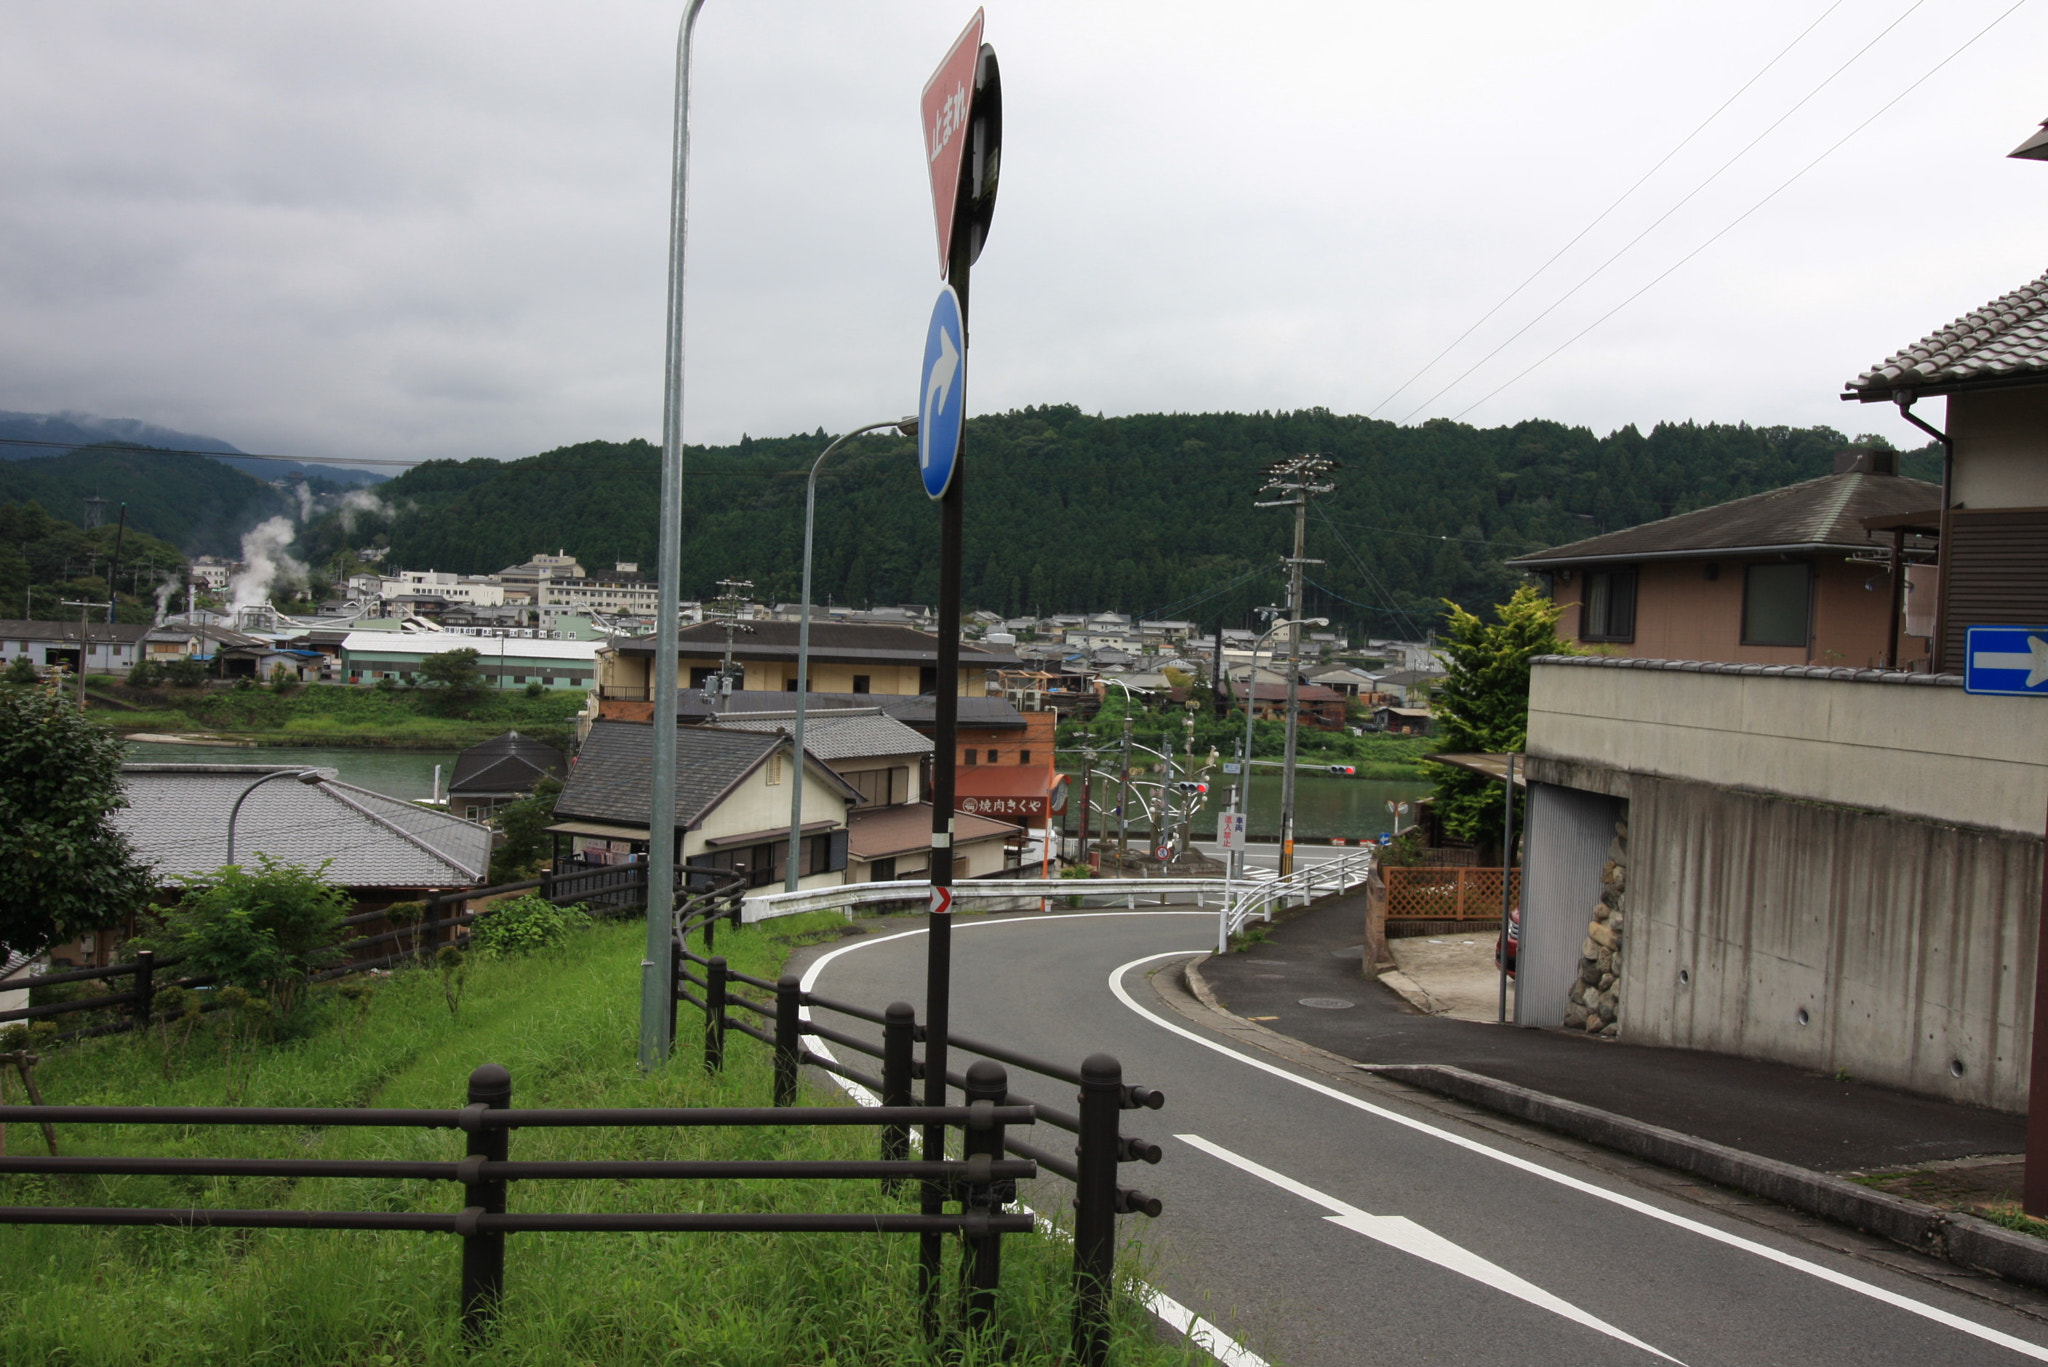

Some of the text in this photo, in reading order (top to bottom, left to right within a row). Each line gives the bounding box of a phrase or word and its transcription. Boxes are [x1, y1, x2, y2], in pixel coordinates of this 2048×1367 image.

[931, 80, 966, 162] 止まれ
[979, 798, 1041, 813] 焼肉きくや
[1222, 816, 1233, 848] 進入禁止
[1235, 817, 1243, 832] 車両
